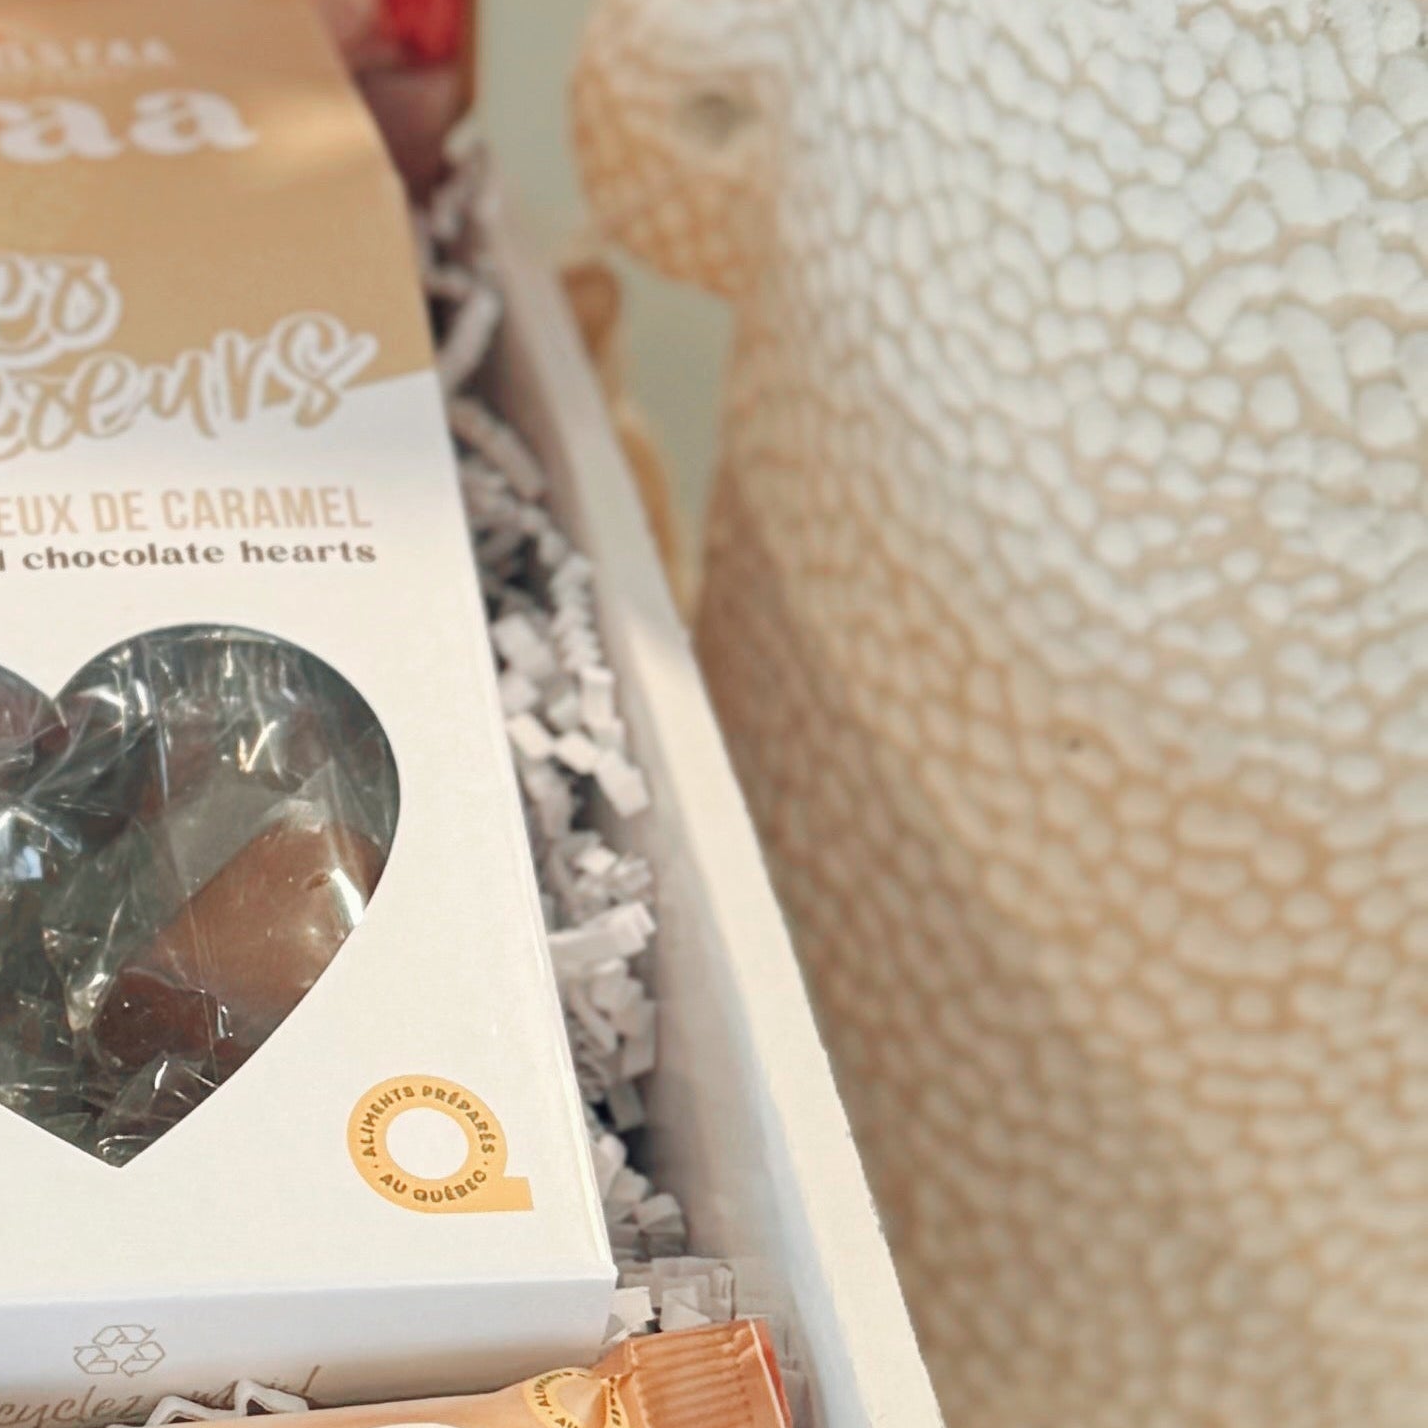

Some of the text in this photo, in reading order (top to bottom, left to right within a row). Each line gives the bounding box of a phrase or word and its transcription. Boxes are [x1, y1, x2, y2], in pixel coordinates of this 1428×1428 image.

[91, 491, 145, 535] DE
[161, 485, 373, 532] CARAMEL
[21, 541, 225, 572] chocolate
[240, 539, 378, 566] hearts
[360, 1085, 497, 1158] ALIMENTS PRÉPARÉS
[379, 1169, 487, 1204] AU QUÉBEC
